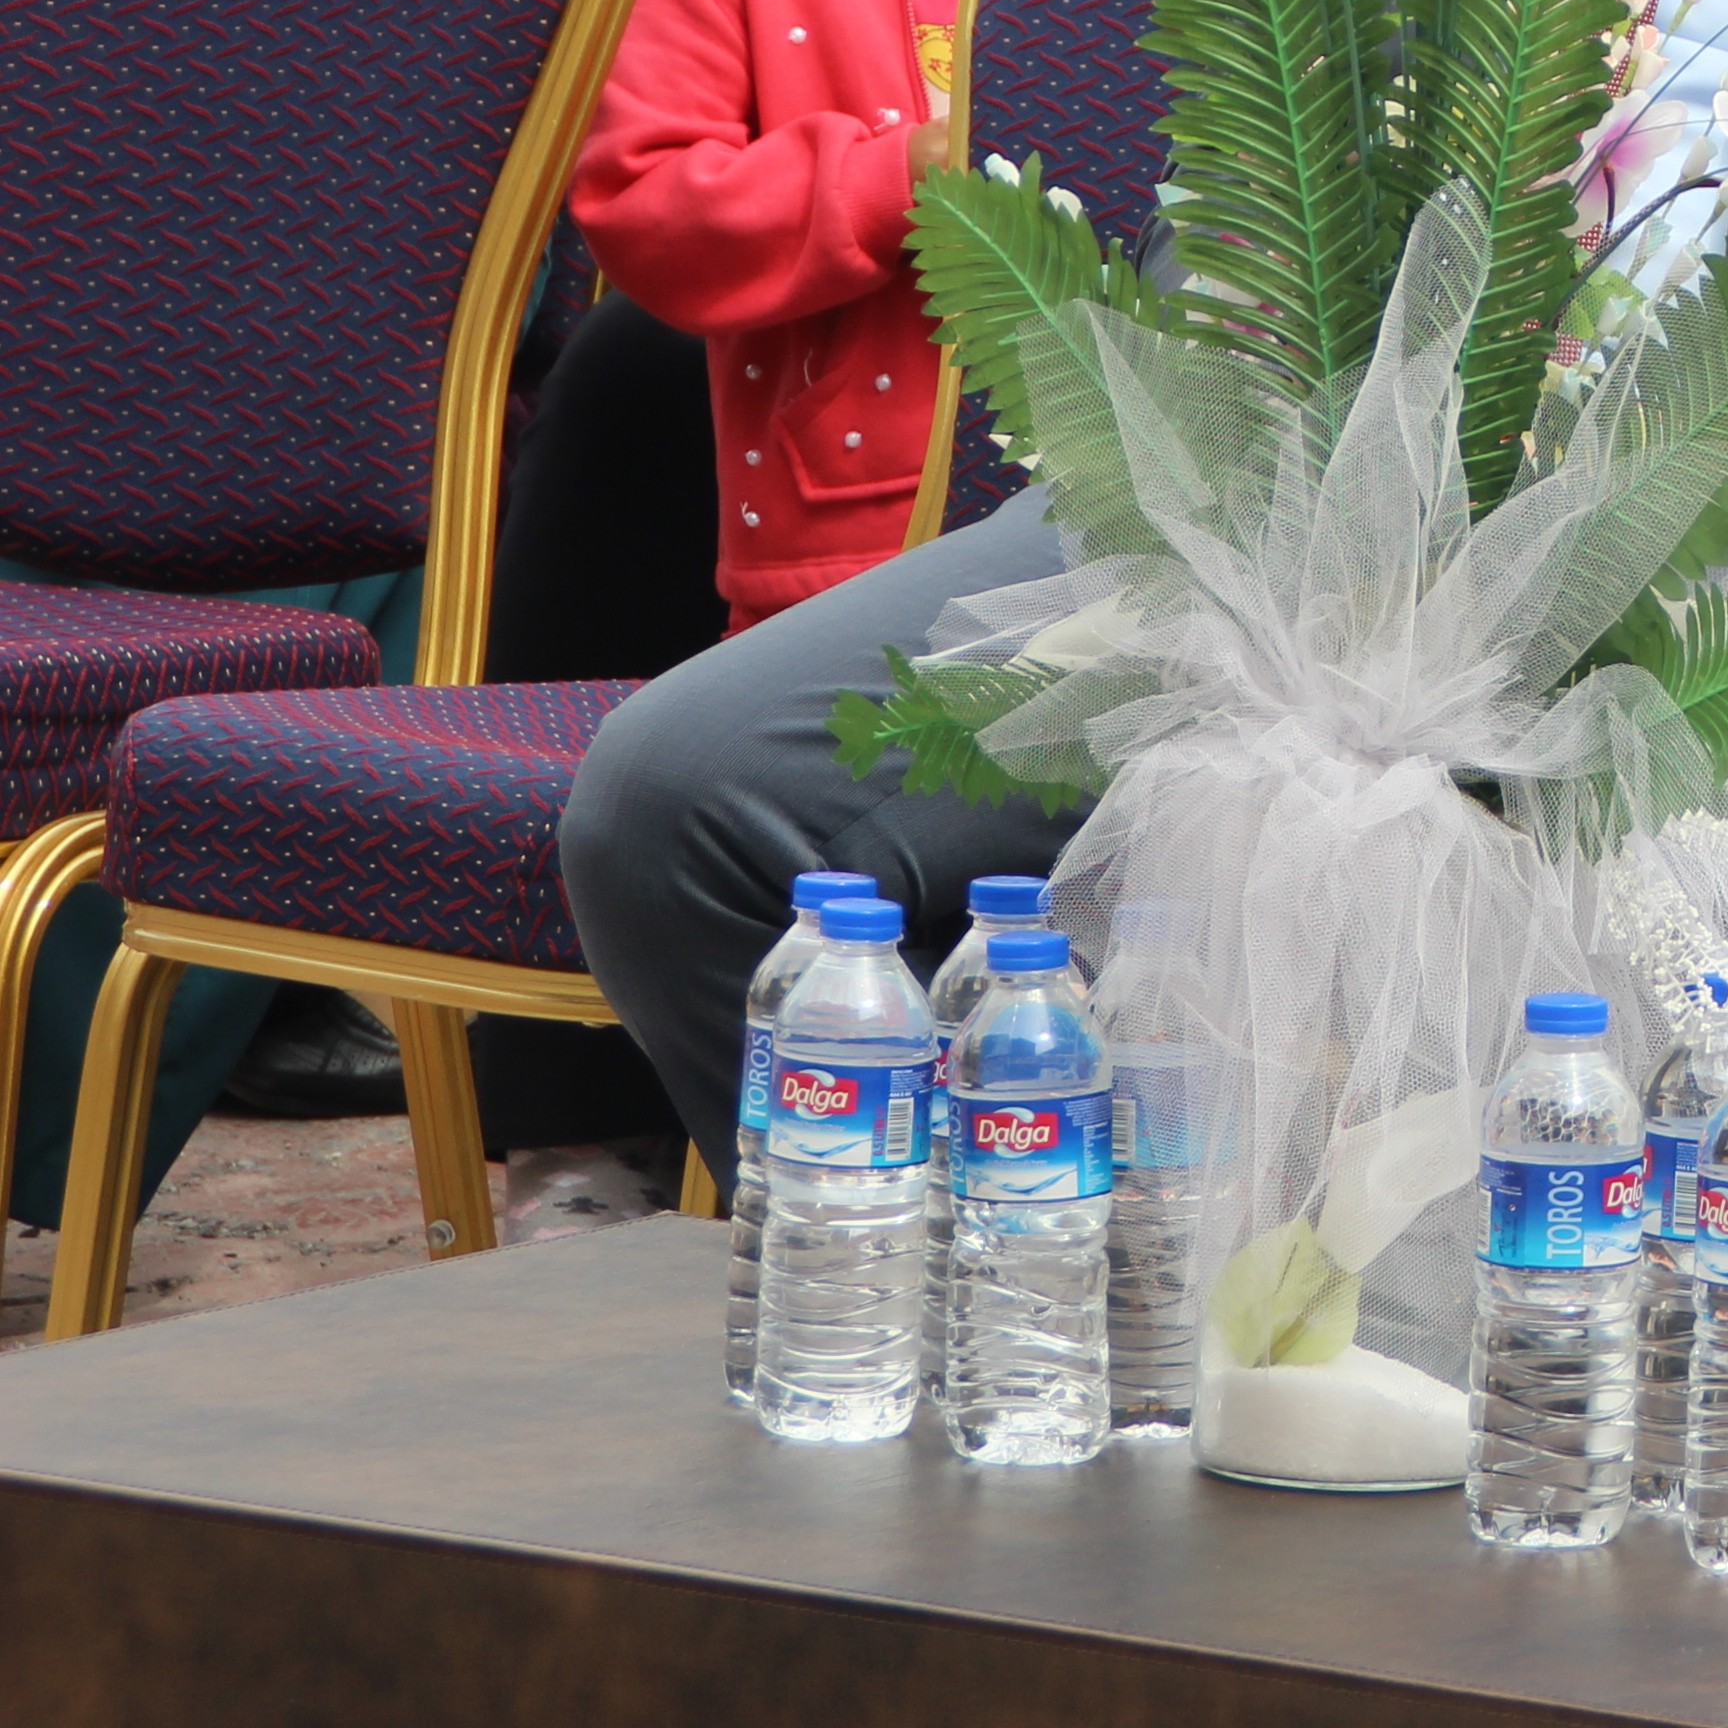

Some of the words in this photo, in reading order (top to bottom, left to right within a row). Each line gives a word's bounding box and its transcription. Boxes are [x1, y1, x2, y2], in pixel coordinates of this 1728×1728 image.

[746, 1032, 772, 1118] TOROS
[781, 1076, 849, 1114] Dalga
[977, 1118, 1051, 1151] Dalga
[1606, 1175, 1643, 1208] Dalg
[1546, 1170, 1585, 1260] TOROS
